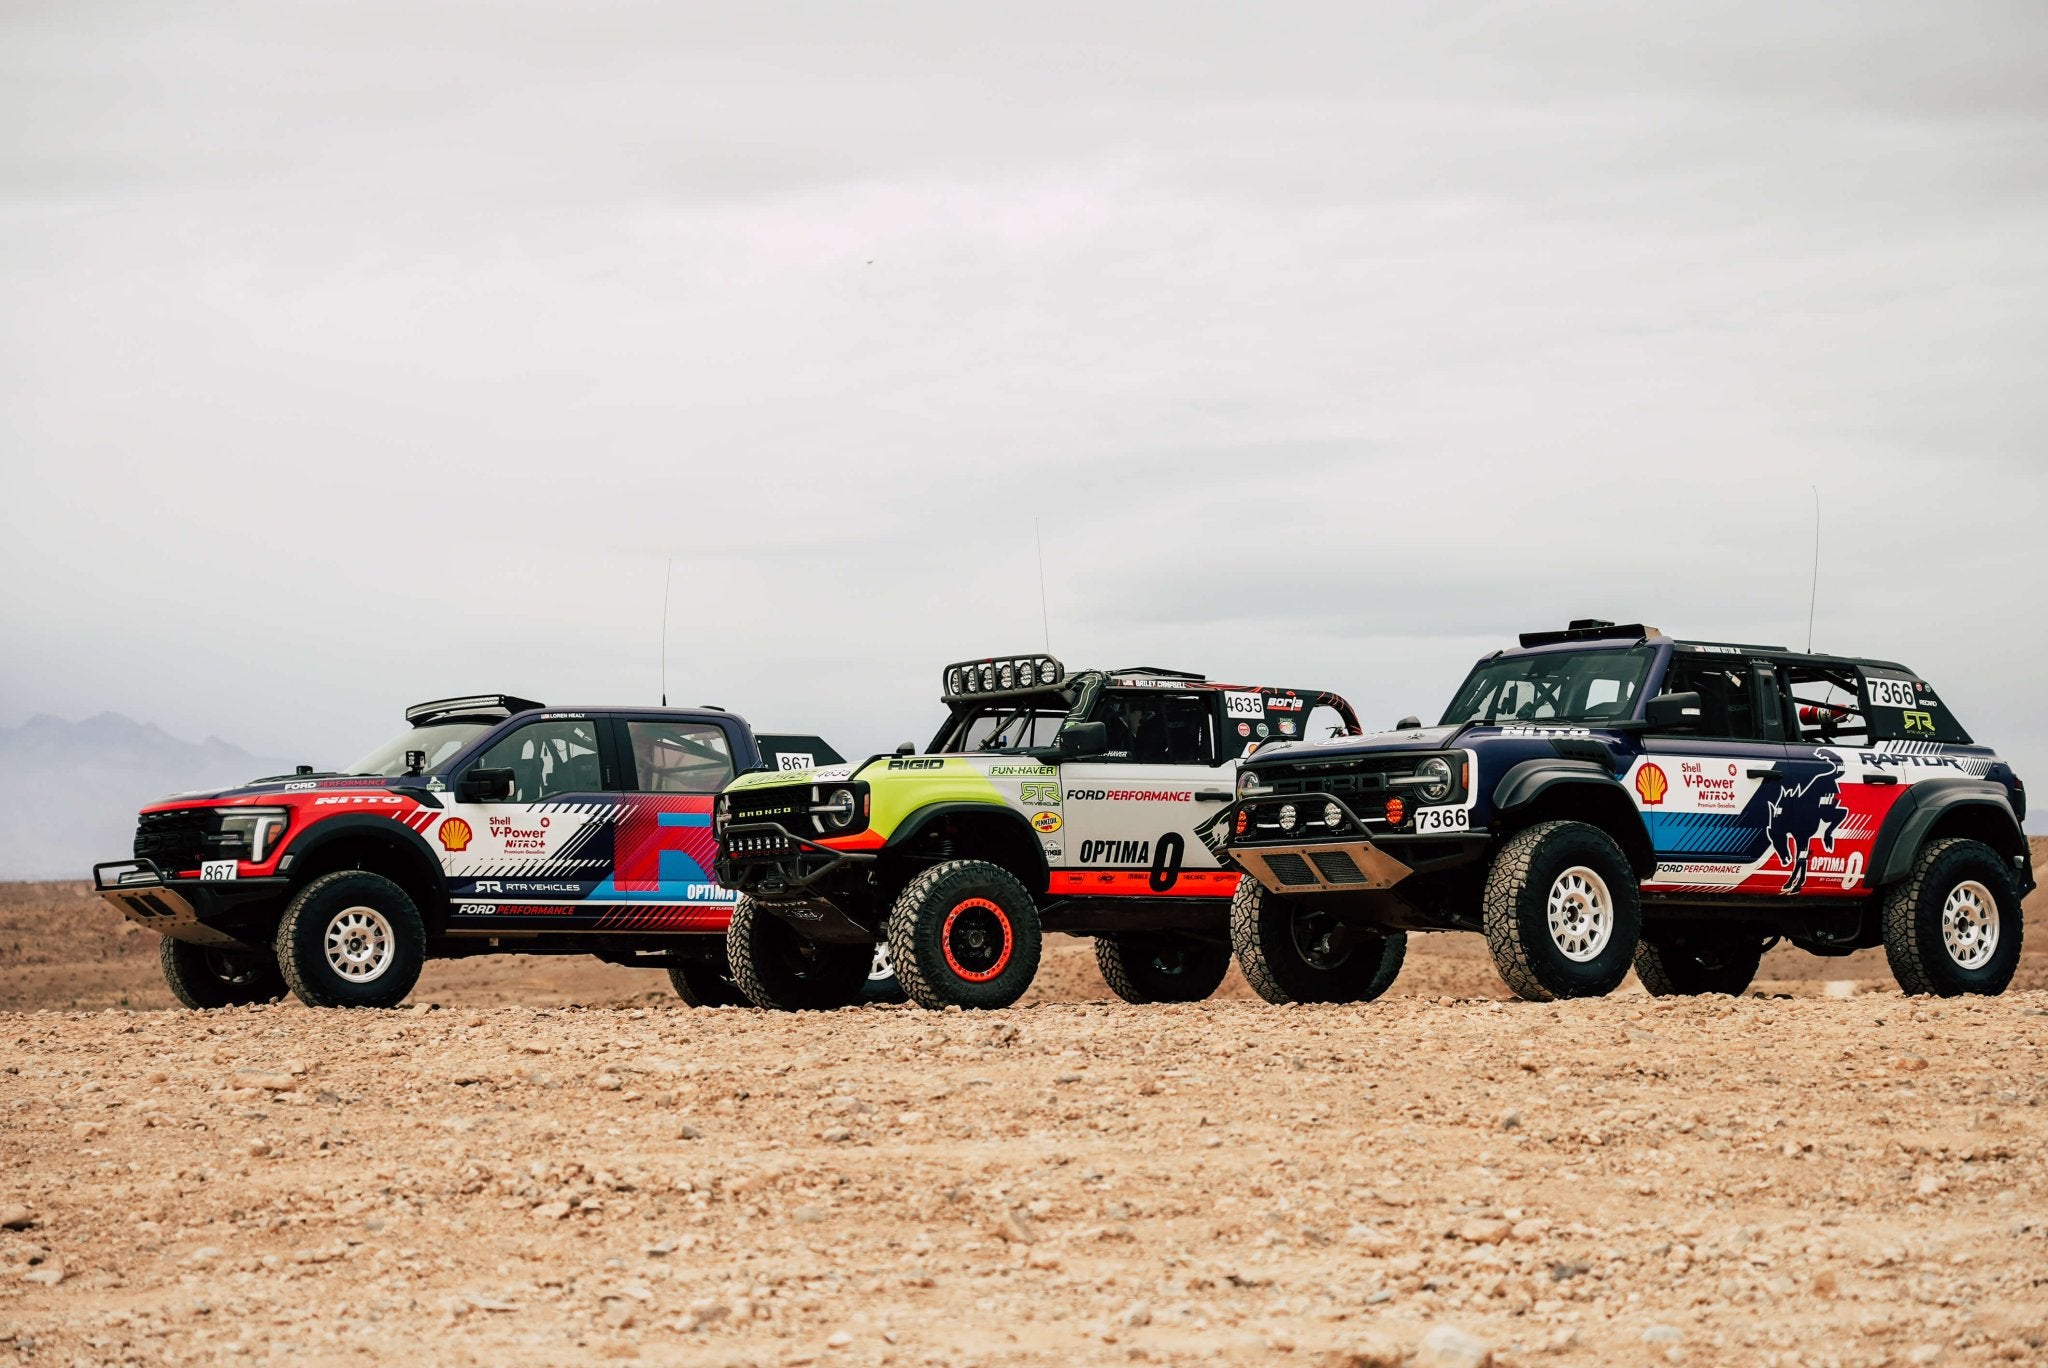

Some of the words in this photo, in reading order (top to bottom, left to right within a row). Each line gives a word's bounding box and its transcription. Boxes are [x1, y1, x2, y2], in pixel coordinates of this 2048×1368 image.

[1867, 680, 1914, 705] 7366
[1225, 696, 1262, 713] 4635
[1501, 726, 1591, 737] NITTO
[781, 756, 810, 771] 867
[888, 759, 944, 770] RIGID
[1681, 762, 1702, 773] Shell
[1858, 752, 1966, 772] RAPTOR
[991, 766, 1054, 776] FUN-HAVER
[284, 781, 317, 791] FORD
[318, 778, 388, 789] PERFORMANCE
[1683, 774, 1735, 789] V-Power
[314, 796, 403, 805] NITTO
[1066, 789, 1106, 801] FORD
[1106, 790, 1192, 802] PERFORMANCE
[738, 807, 792, 818] BRONCO
[1417, 808, 1467, 830] 7366
[489, 816, 511, 826] Shell
[490, 826, 546, 839] V-Power
[1079, 839, 1150, 864] OPTIMA
[1656, 863, 1683, 873] FORD
[1683, 864, 1742, 874] PERFORMANCE
[1810, 856, 1845, 872] OPTIMA
[203, 864, 234, 881] 867
[505, 883, 528, 891] RTR
[528, 883, 581, 892] VEHICLES
[687, 883, 734, 900] OPTIMA
[459, 904, 497, 915] FORD
[496, 905, 576, 915] PERFORMANCE
